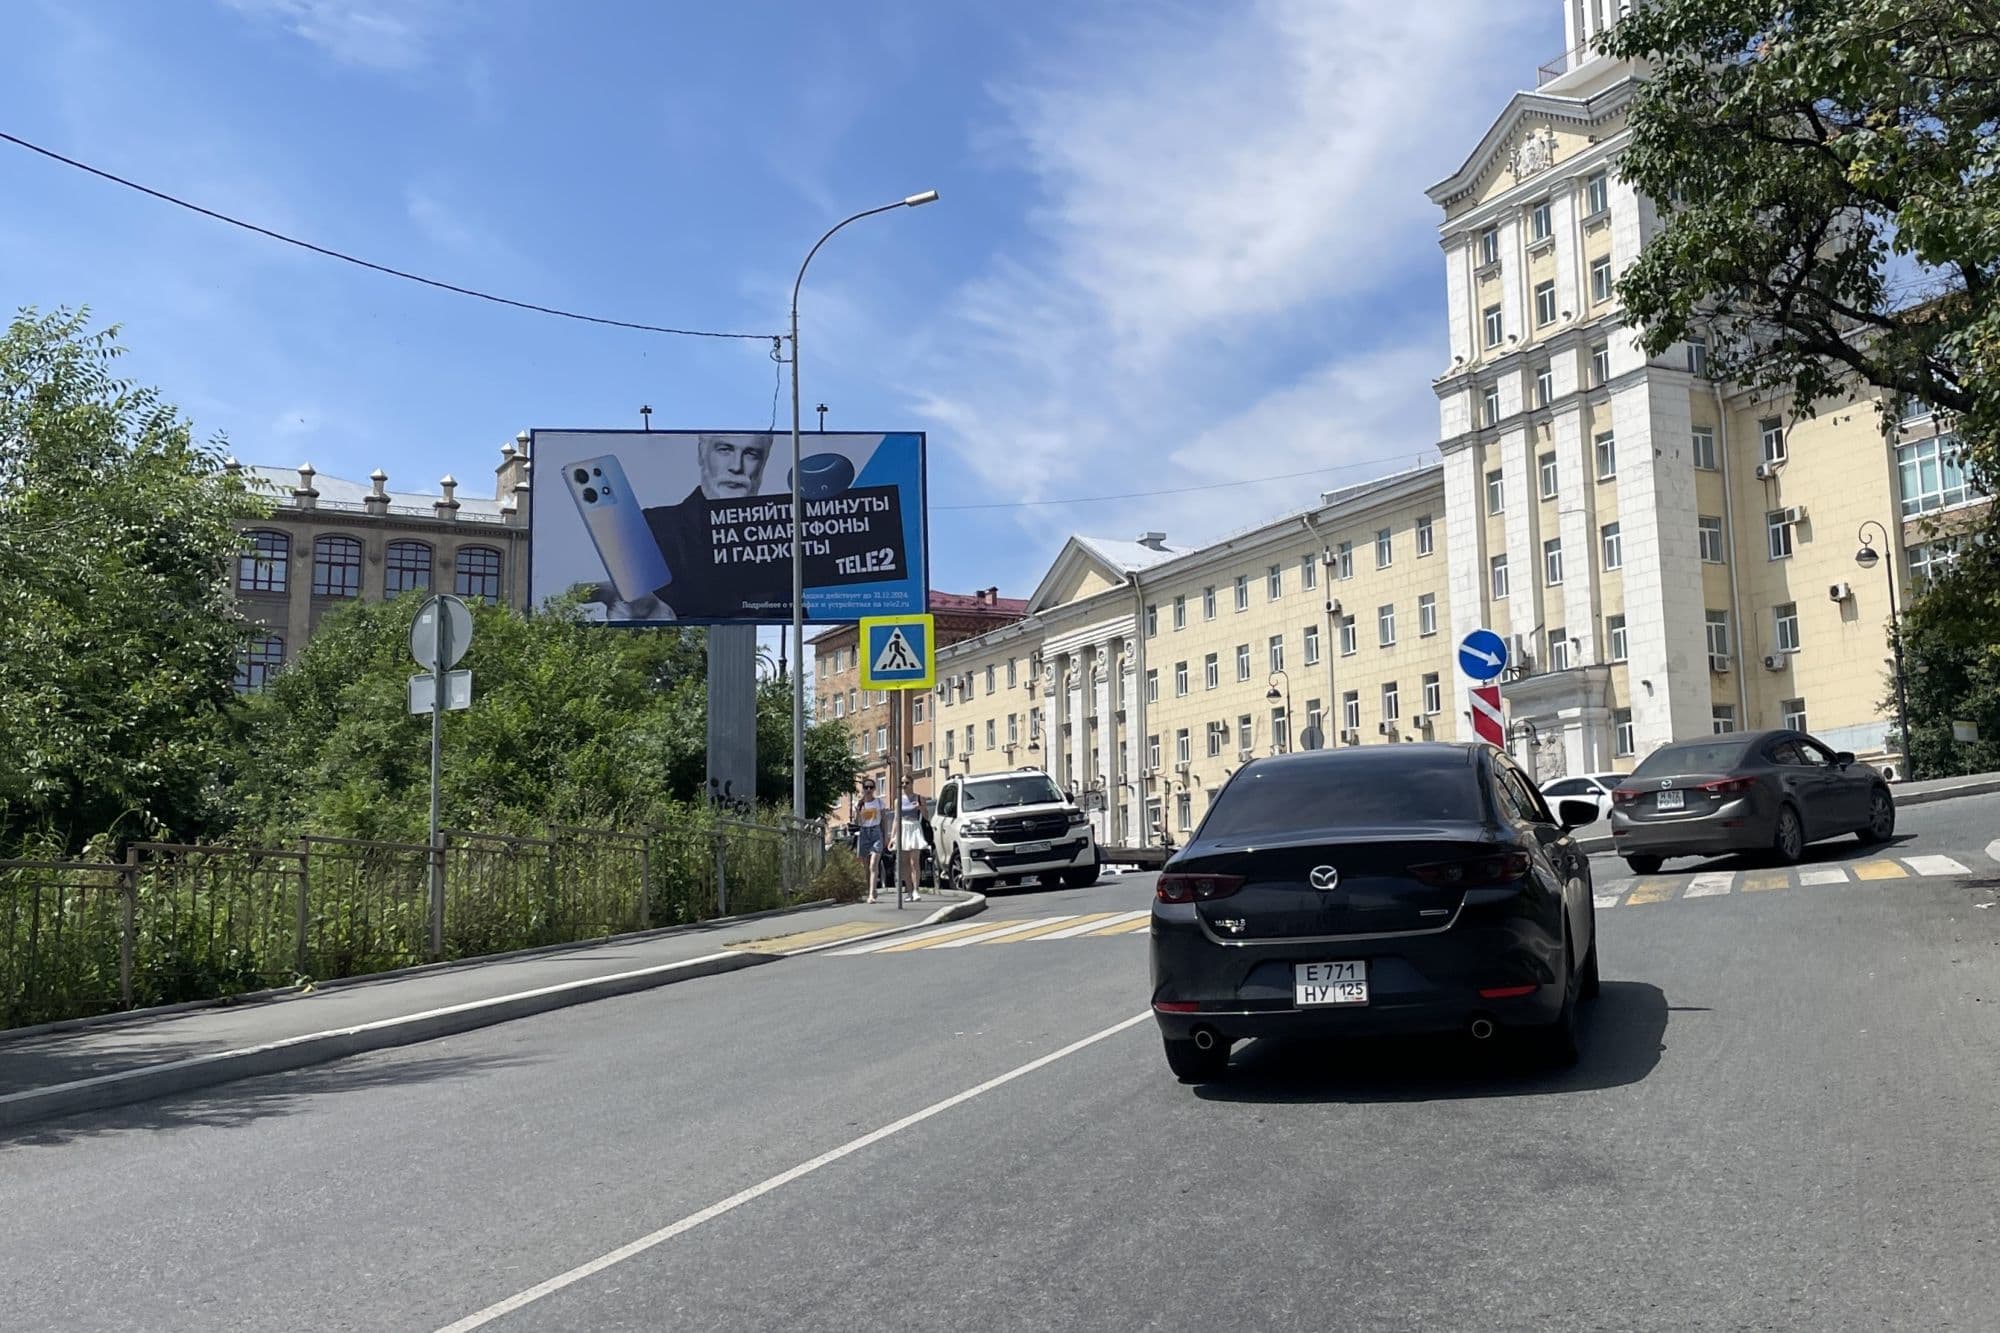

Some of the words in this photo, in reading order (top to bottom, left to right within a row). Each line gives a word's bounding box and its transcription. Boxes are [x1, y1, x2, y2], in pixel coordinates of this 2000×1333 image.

[805, 496, 890, 517] МИНУТЫ
[712, 528, 739, 545] НА
[744, 517, 870, 542] СМАРТФОНЫ
[713, 548, 727, 564] И
[835, 547, 896, 575] TELE2
[742, 601, 781, 610] Подробнее
[1324, 964, 1355, 980] 771
[1305, 986, 1329, 1002] НУ
[1339, 983, 1363, 996] 125
